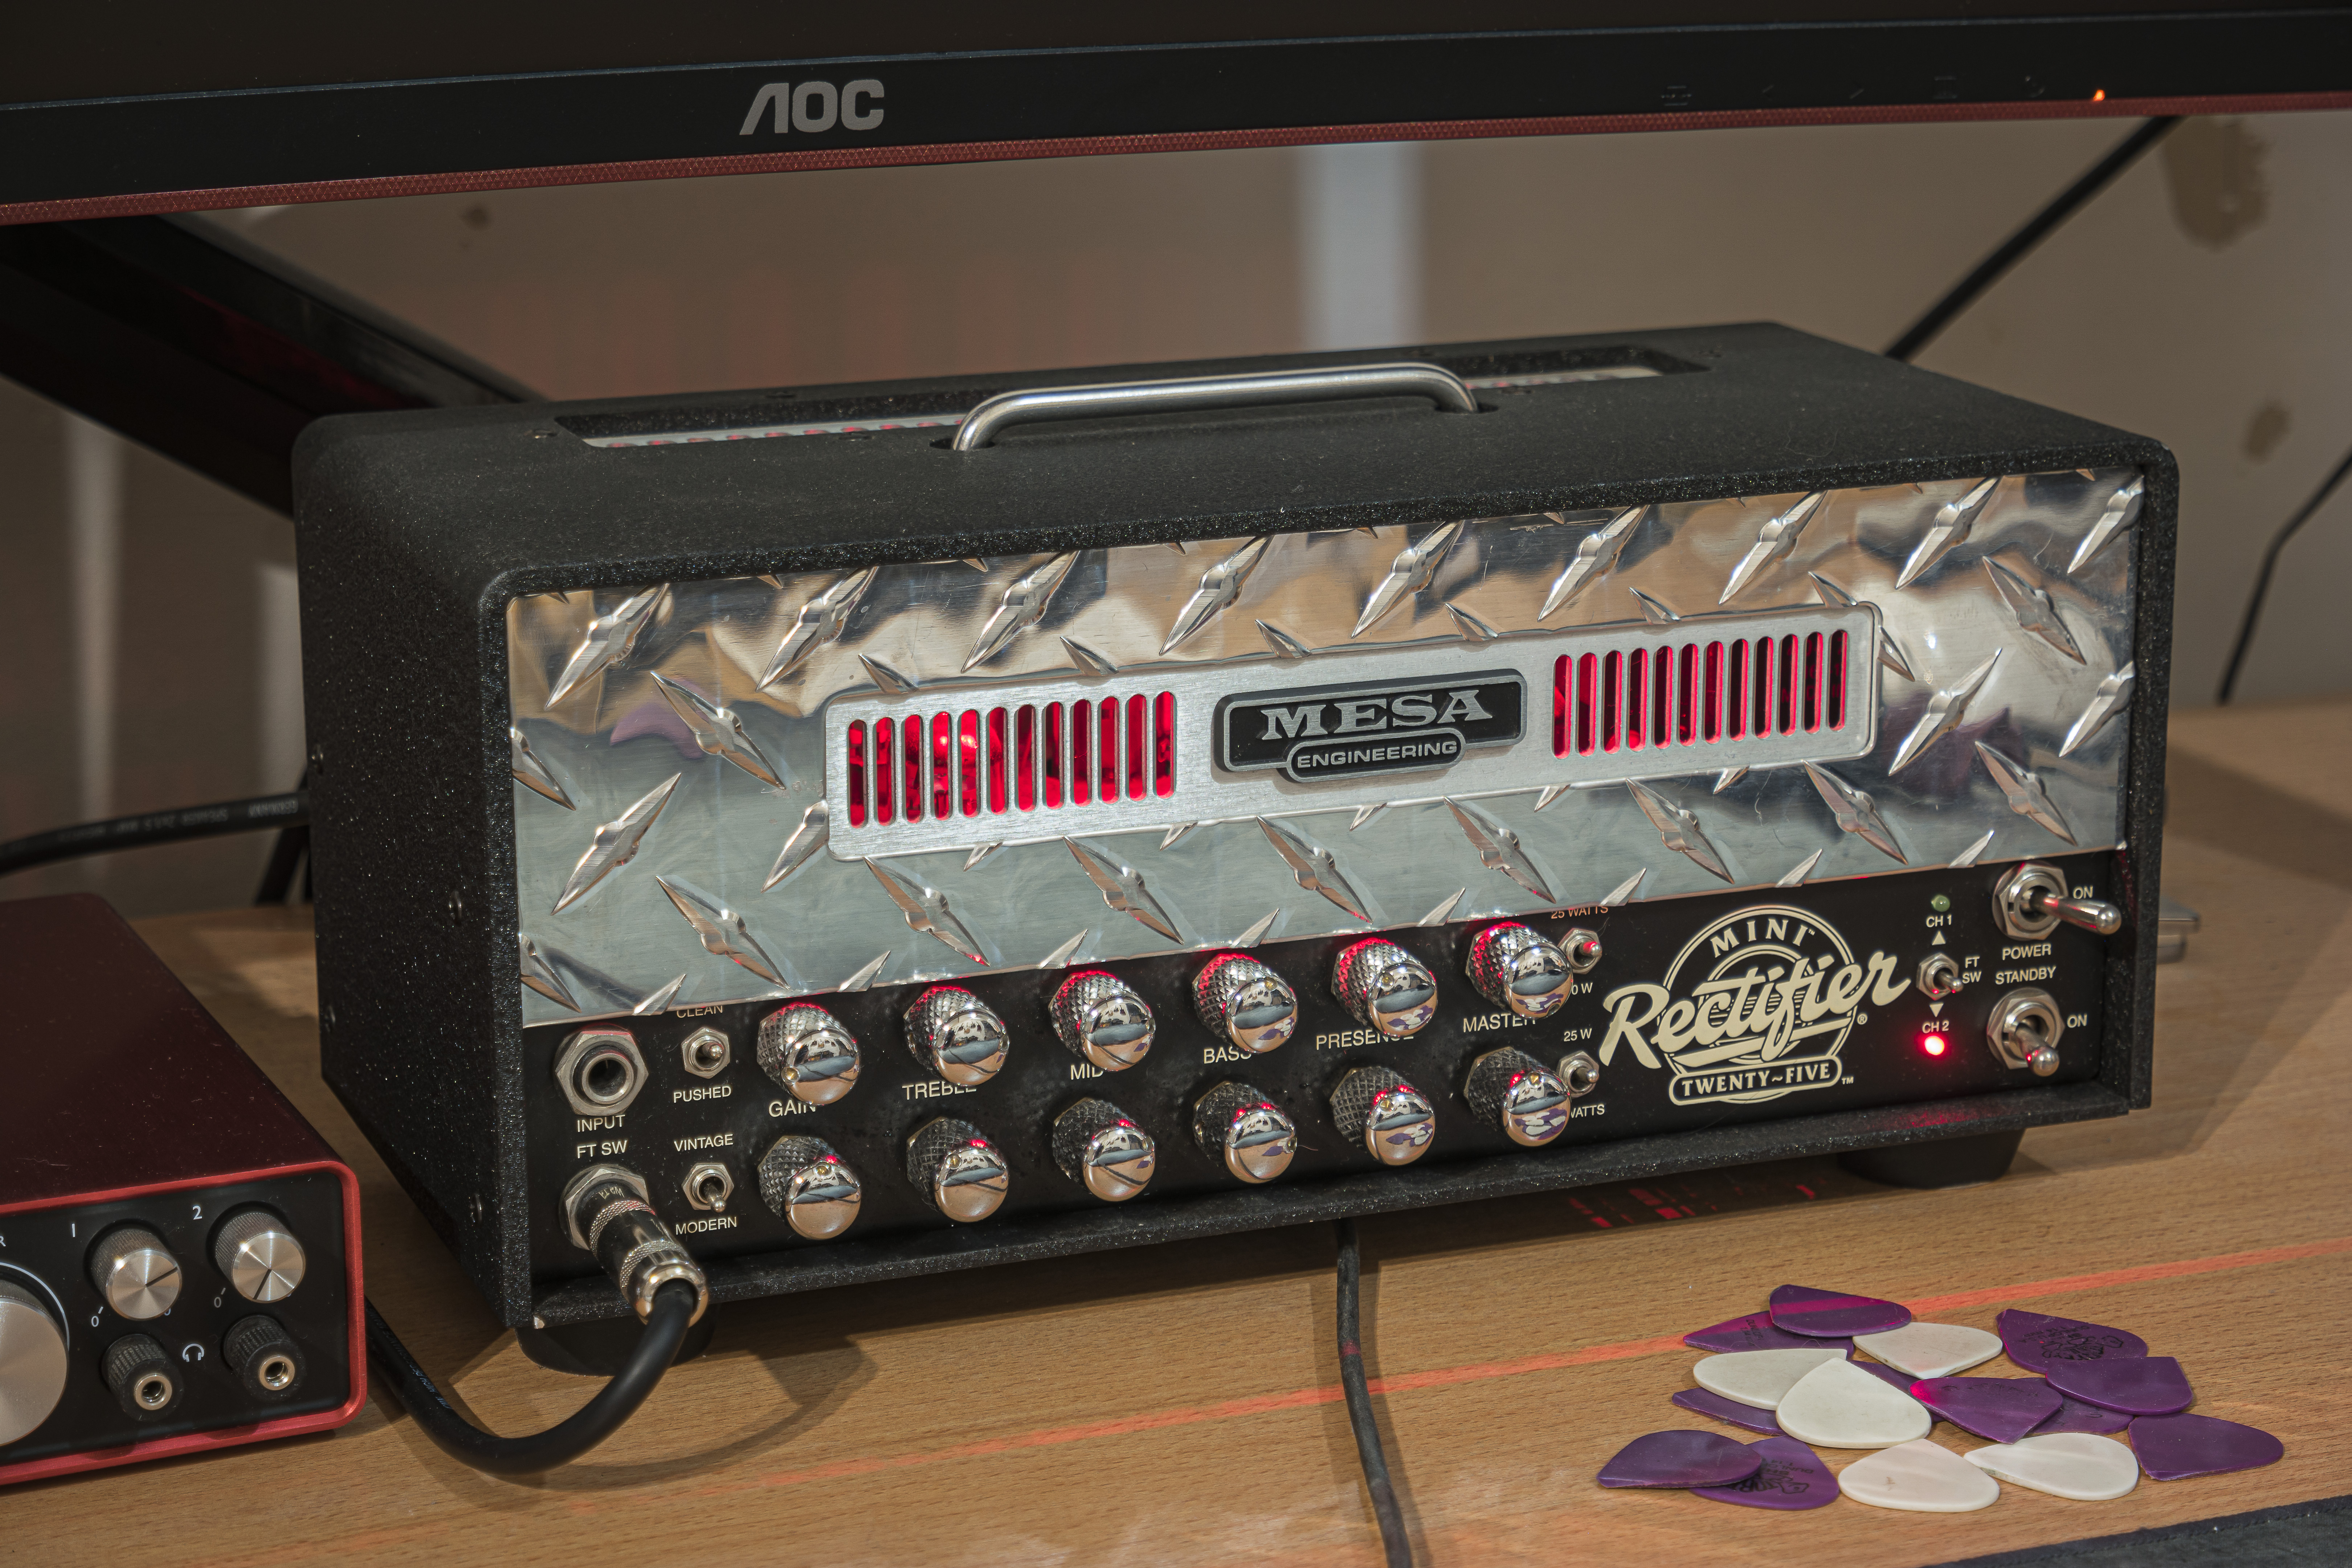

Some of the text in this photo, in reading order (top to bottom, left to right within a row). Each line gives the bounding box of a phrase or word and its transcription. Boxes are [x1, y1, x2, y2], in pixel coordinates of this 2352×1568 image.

[739, 79, 884, 135] AOC
[1261, 690, 1493, 740] MESA
[1297, 741, 1457, 769] ENGINEERING
[2073, 886, 2093, 899] ON
[1551, 910, 1565, 919] 25
[1926, 915, 1952, 927] CH 1
[2002, 944, 2051, 960] POWER
[1965, 956, 1980, 968] FT
[1962, 971, 1981, 984] SW
[1996, 966, 2056, 984] STANDBY
[1571, 982, 1593, 995] 0 W
[677, 1005, 723, 1018] CLEAN
[1599, 951, 1911, 1069] Rectifier
[1922, 1021, 1949, 1034] CH 2
[2067, 1015, 2087, 1028] ON
[1316, 1029, 1414, 1050] PRESEN
[1564, 1025, 1592, 1042] 25 W
[1071, 1063, 1103, 1080] MID
[673, 1086, 732, 1103] PUSHED
[577, 1115, 625, 1132] INPUT
[577, 1140, 628, 1159] FT SW
[674, 1134, 734, 1152] VINTAGE
[193, 1205, 202, 1219] 2
[675, 1217, 737, 1235] MODERN
[214, 1297, 221, 1308] 0
[91, 1316, 99, 1327] 0
